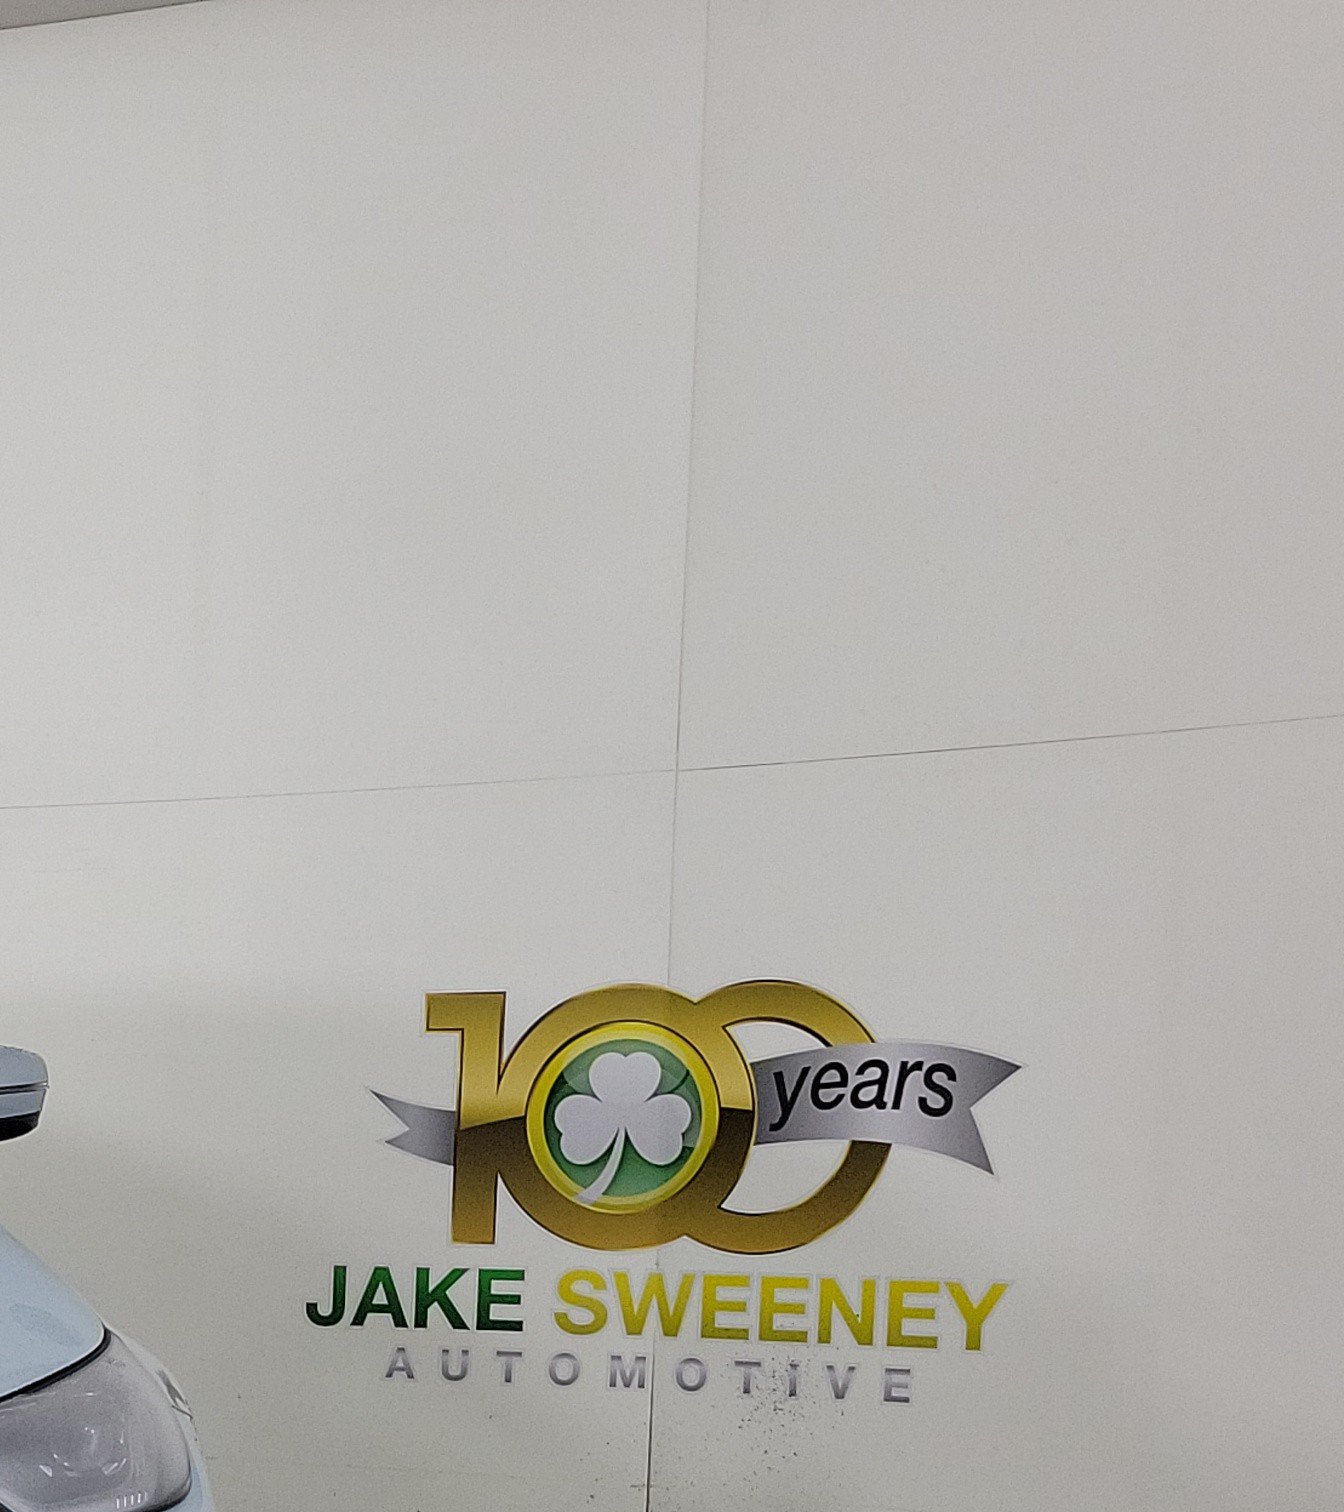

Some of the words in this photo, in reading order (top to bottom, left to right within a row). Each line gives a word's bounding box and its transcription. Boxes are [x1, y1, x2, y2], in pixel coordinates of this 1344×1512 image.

[768, 1057, 957, 1132] years
[306, 1265, 525, 1332] JAKE
[554, 1269, 1010, 1351] SWEENEY
[385, 1347, 912, 1404] AUTOMOTIVE
